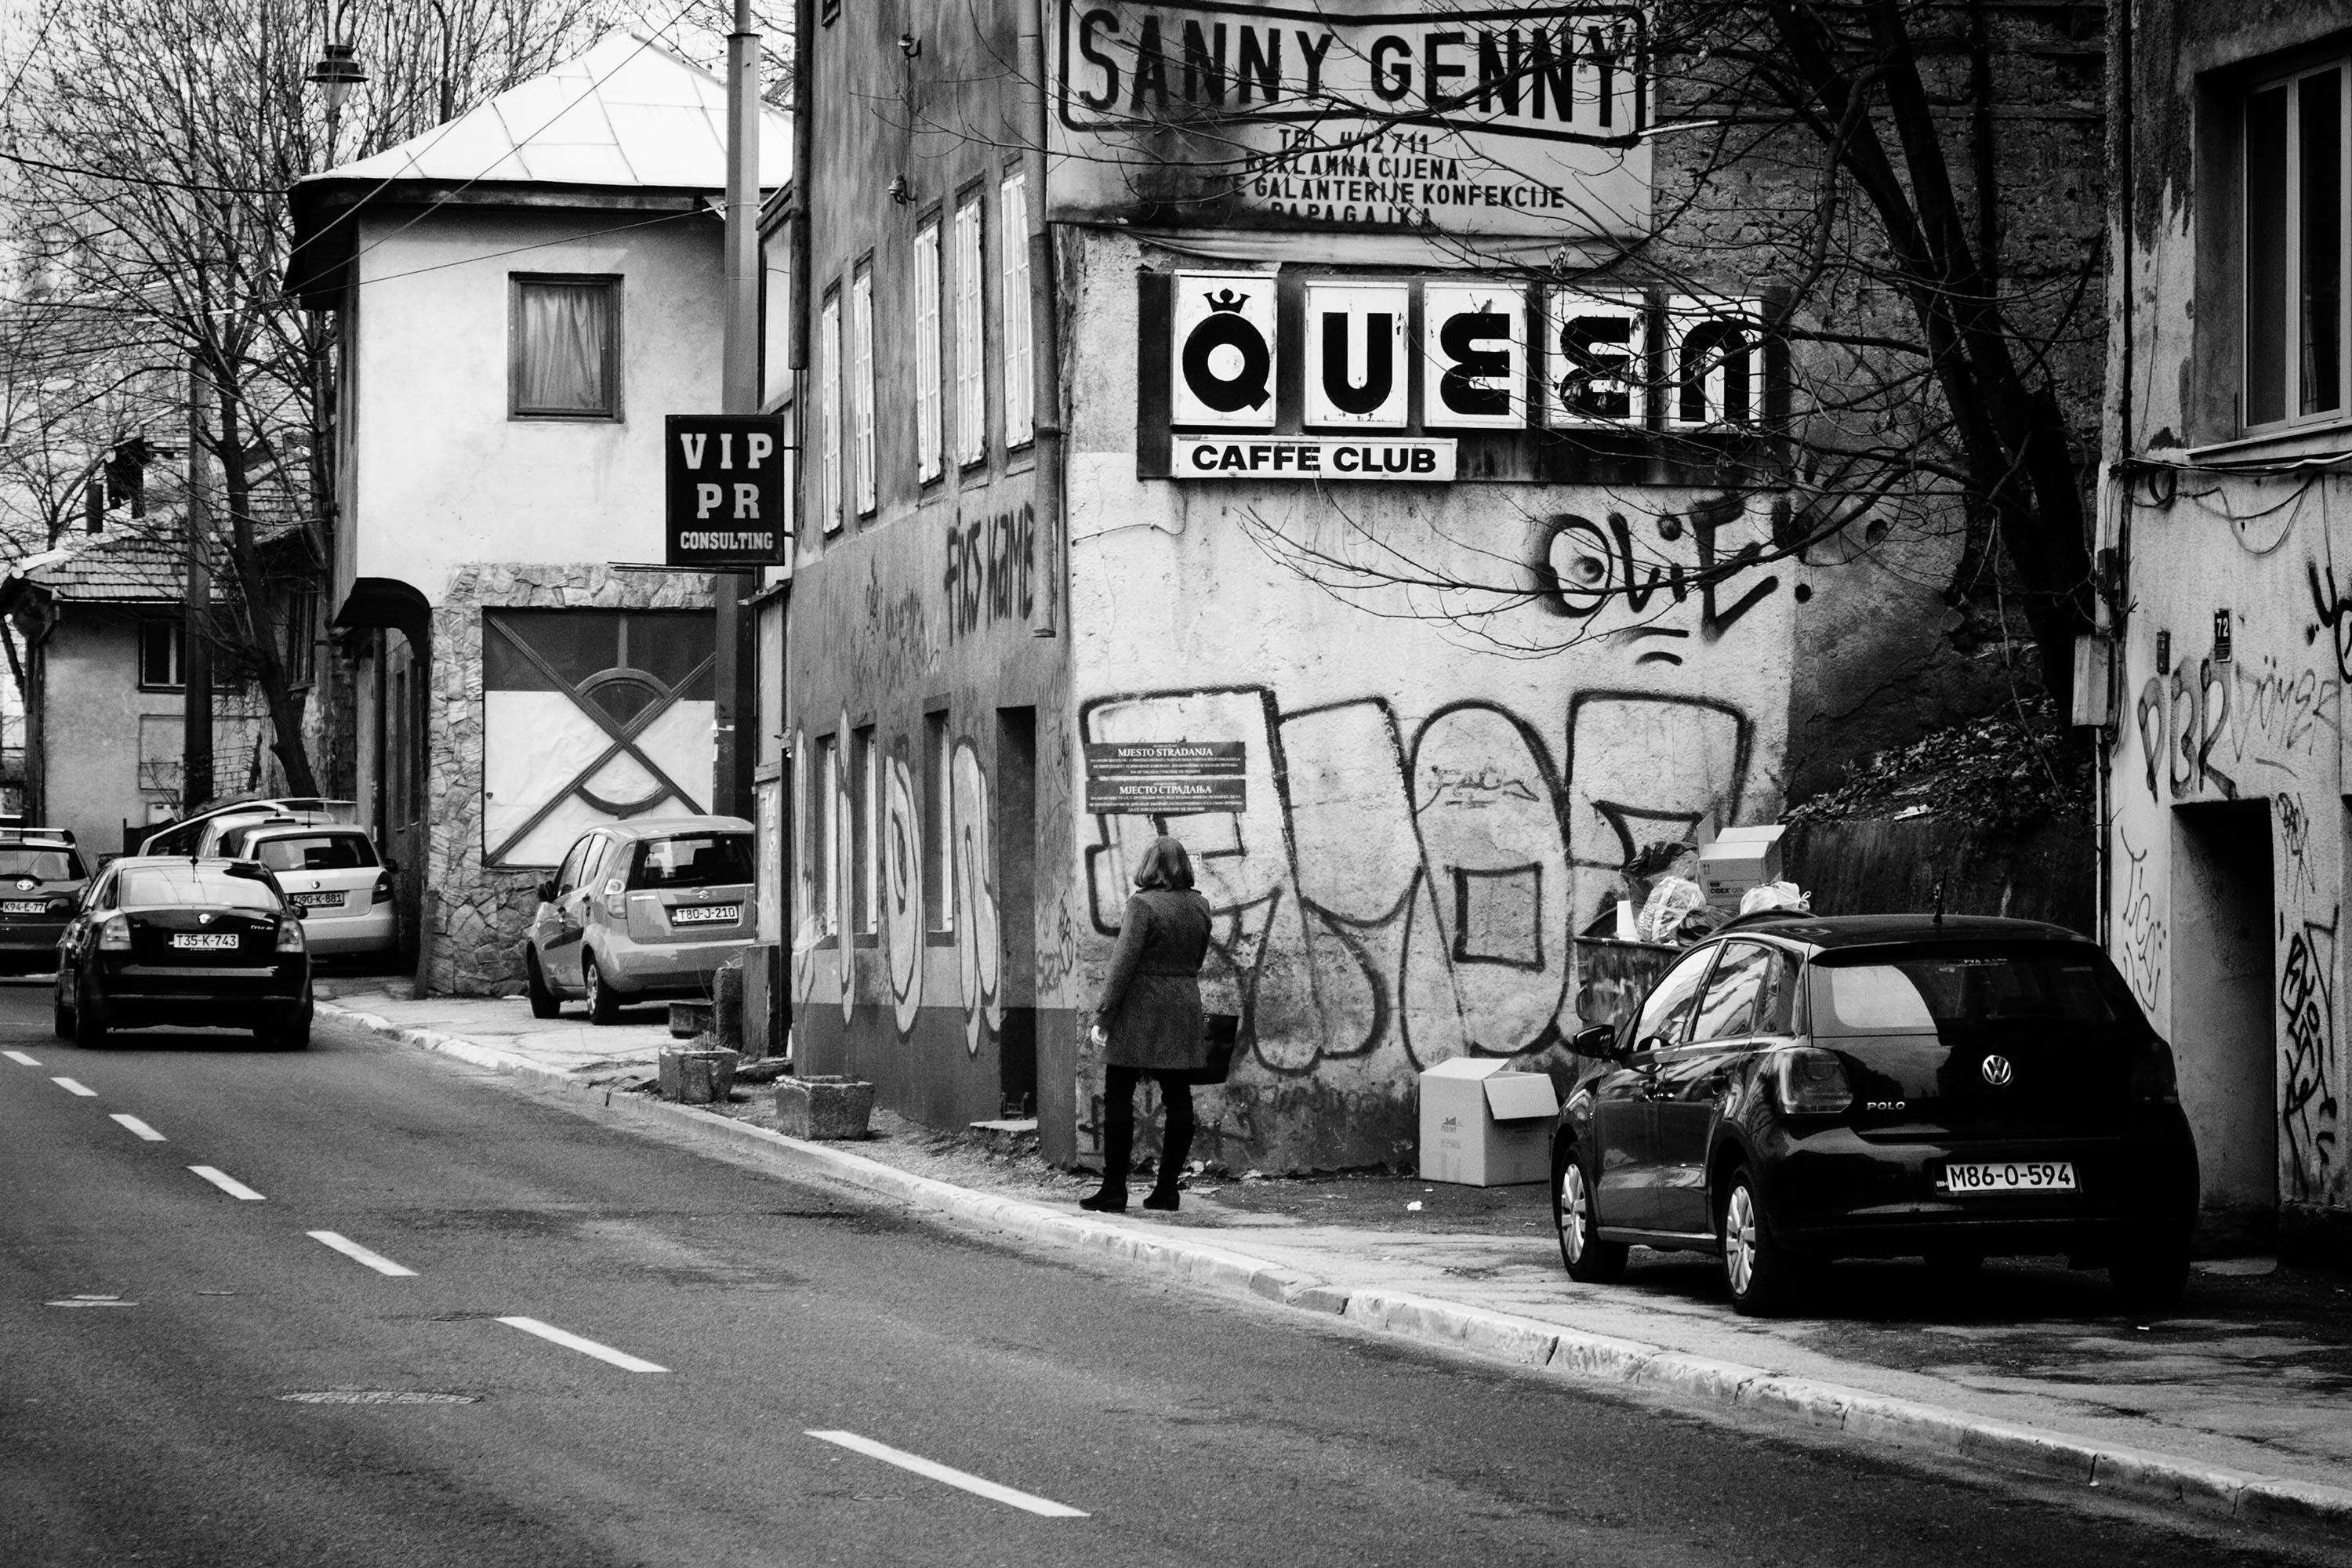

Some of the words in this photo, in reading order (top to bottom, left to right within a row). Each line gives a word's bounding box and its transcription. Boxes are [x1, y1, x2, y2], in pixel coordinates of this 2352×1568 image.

[1079, 9, 1334, 114] SANNY
[1369, 24, 1628, 128] GENNY
[1392, 133, 1428, 154] 711
[1377, 158, 1459, 180] CIJENA
[1254, 177, 1414, 203] GALANTERIJE
[1423, 183, 1565, 208] KONFEKCIJE
[1182, 310, 1752, 422] QUEEN
[680, 433, 774, 470] VIP
[1192, 444, 1321, 471] CAFFE
[1332, 446, 1437, 473] CLUB
[696, 483, 760, 519] PR
[680, 531, 774, 550] CONSULTING
[2216, 616, 2229, 637] 72
[1117, 748, 1155, 757] MJESTO
[1156, 748, 1214, 757] STRADANJA
[677, 906, 735, 920] T80-J-210
[176, 935, 237, 947] T35-K-743
[1867, 1101, 1906, 1111] POLO
